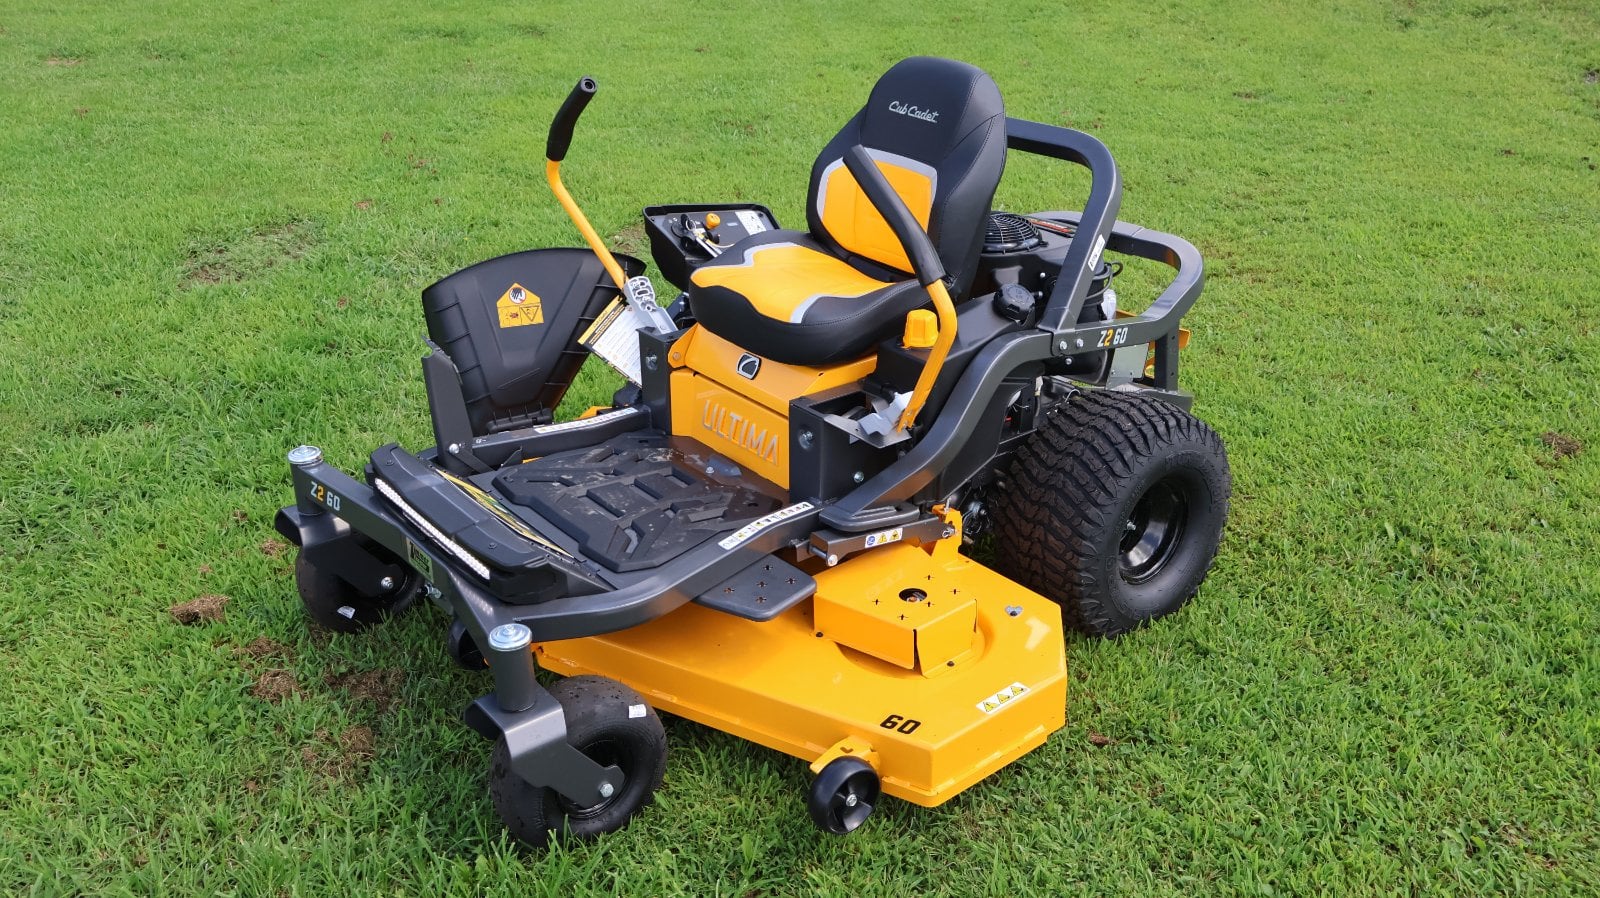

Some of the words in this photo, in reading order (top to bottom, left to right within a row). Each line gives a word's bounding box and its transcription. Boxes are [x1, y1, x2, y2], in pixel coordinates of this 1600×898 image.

[889, 100, 908, 115] Cub
[907, 105, 940, 124] Cadet
[1096, 328, 1115, 348] Z2
[1113, 327, 1129, 345] 60
[702, 399, 779, 466] ULTIMA
[310, 480, 324, 502] Z2
[326, 491, 341, 511] 60
[879, 714, 922, 735] 60
